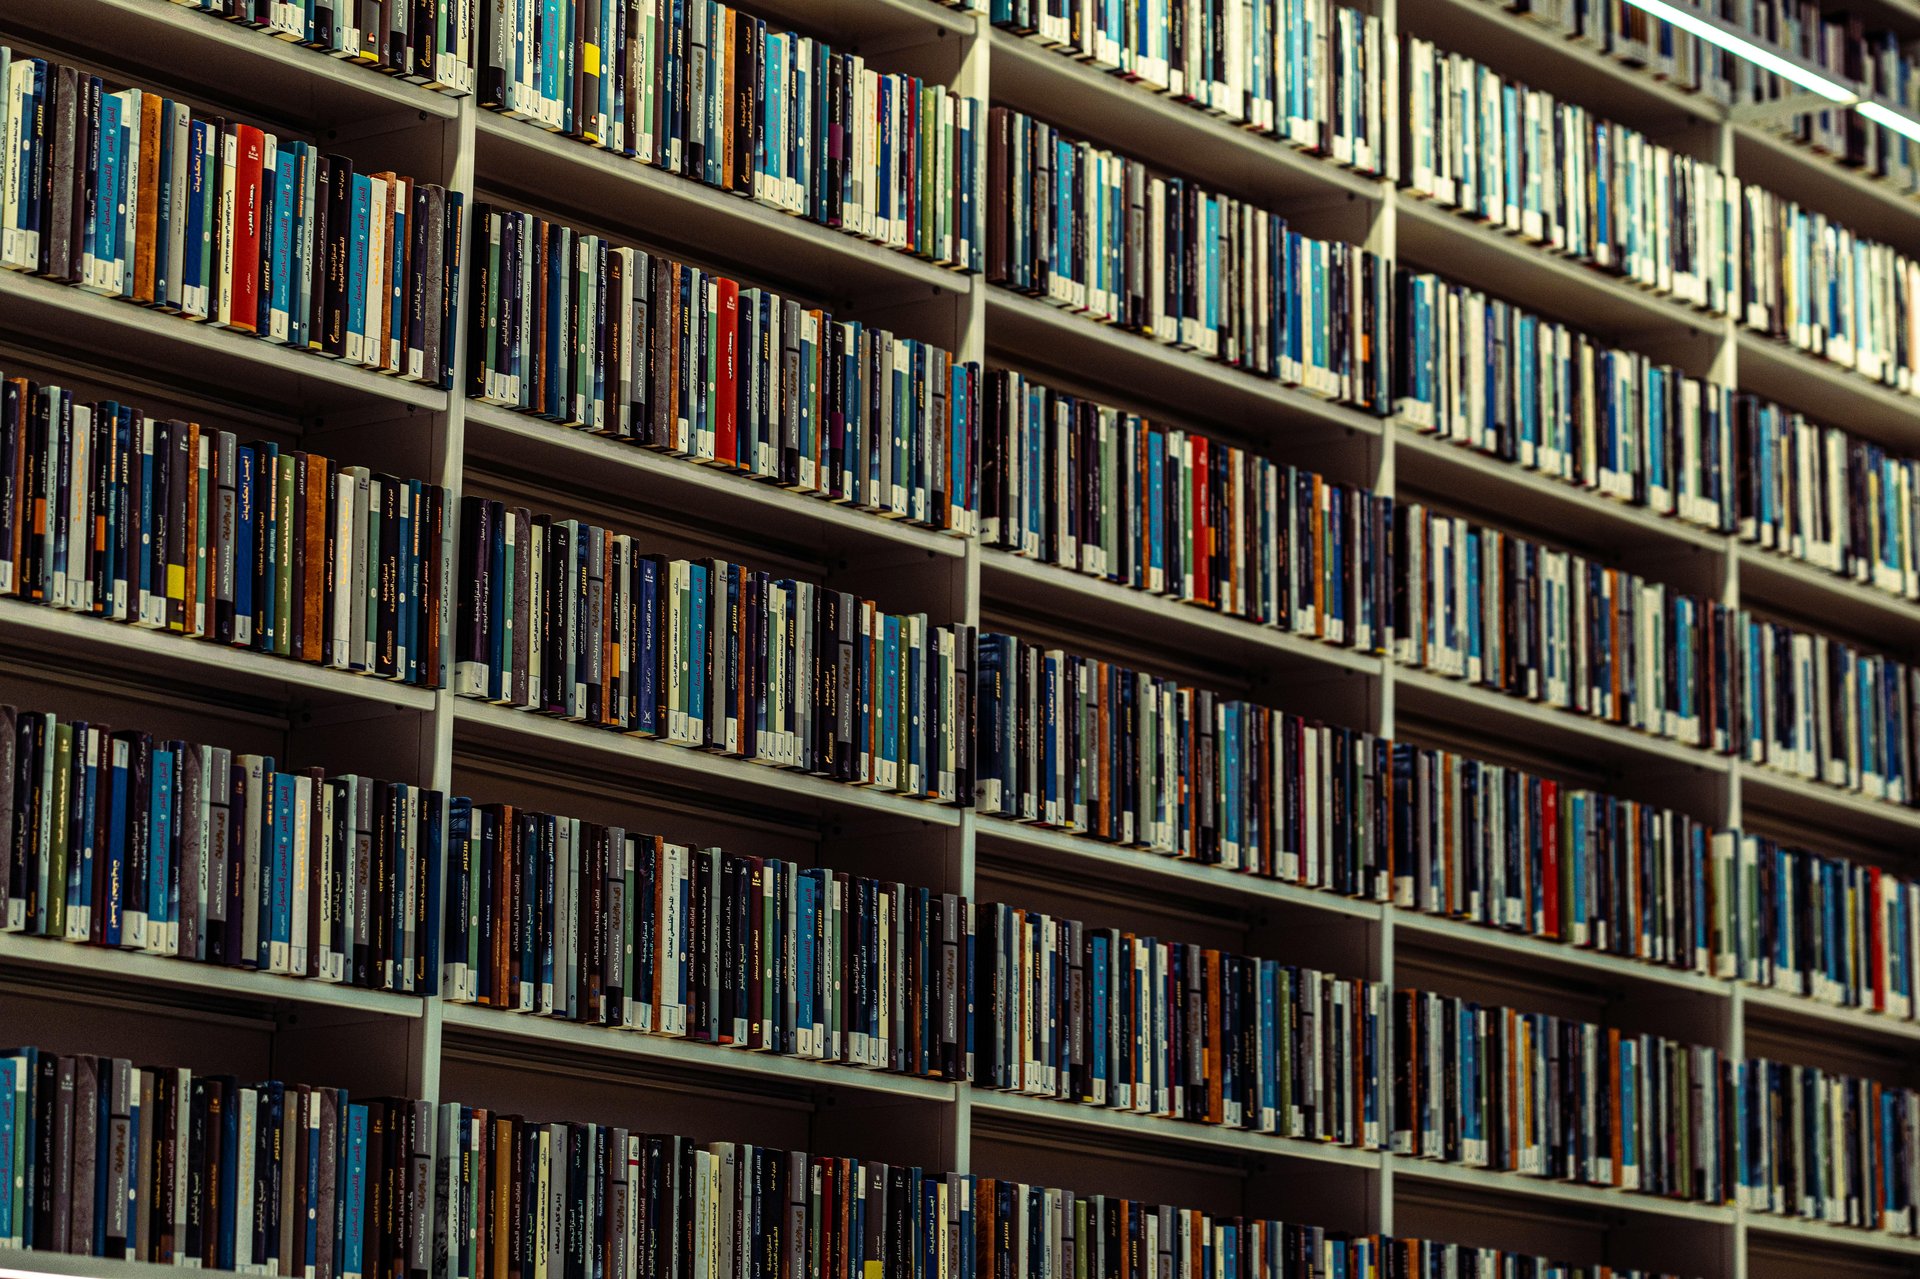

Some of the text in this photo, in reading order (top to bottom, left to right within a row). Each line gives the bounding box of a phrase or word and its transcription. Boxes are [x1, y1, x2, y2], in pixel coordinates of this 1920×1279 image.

[193, 155, 202, 192] الحكايات
[242, 456, 251, 520] أجمل الحكايات
